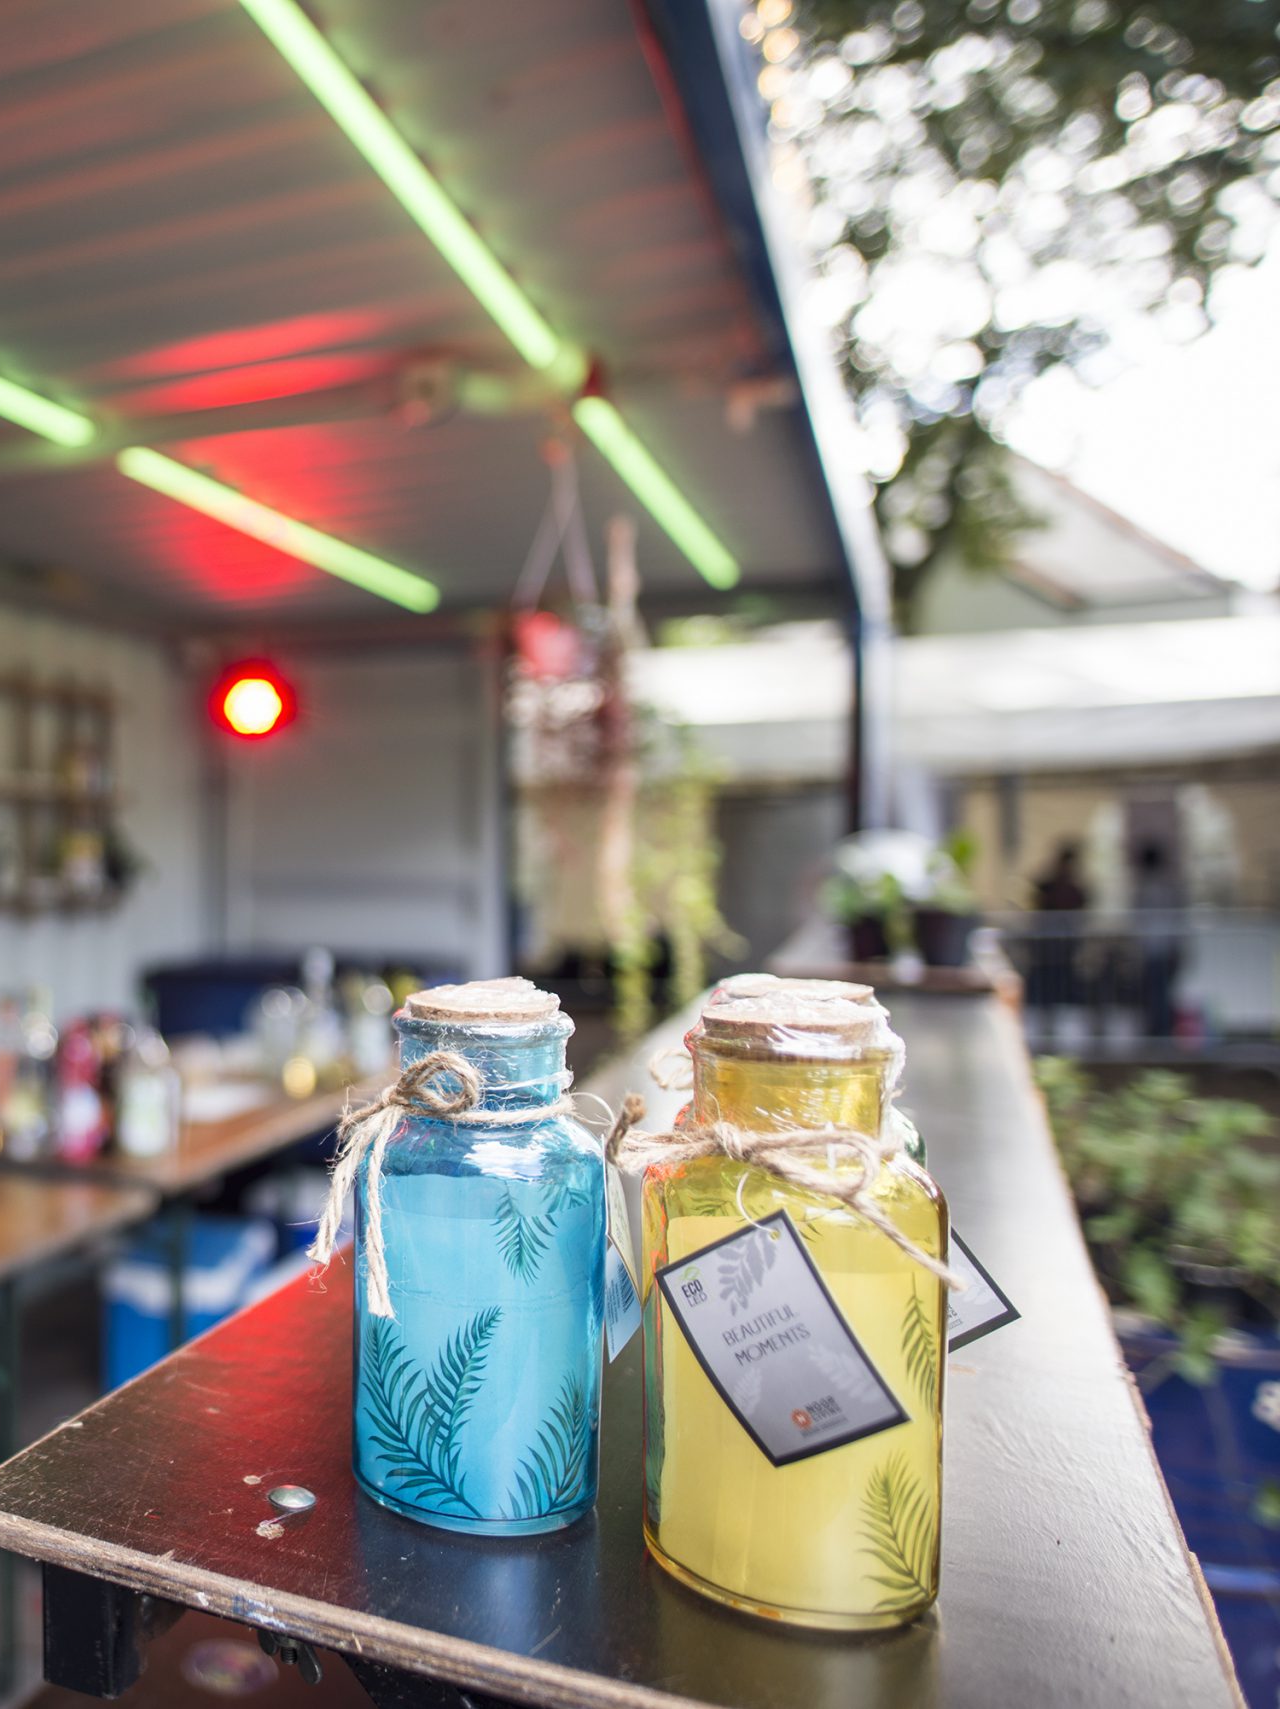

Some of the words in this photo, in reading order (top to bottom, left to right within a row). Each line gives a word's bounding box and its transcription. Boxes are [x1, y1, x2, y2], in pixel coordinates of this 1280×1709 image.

[681, 1280, 703, 1298] ECO
[687, 1293, 708, 1308] LED
[722, 1304, 797, 1346] BEAUTIFUL
[734, 1324, 811, 1367] MOMENTS
